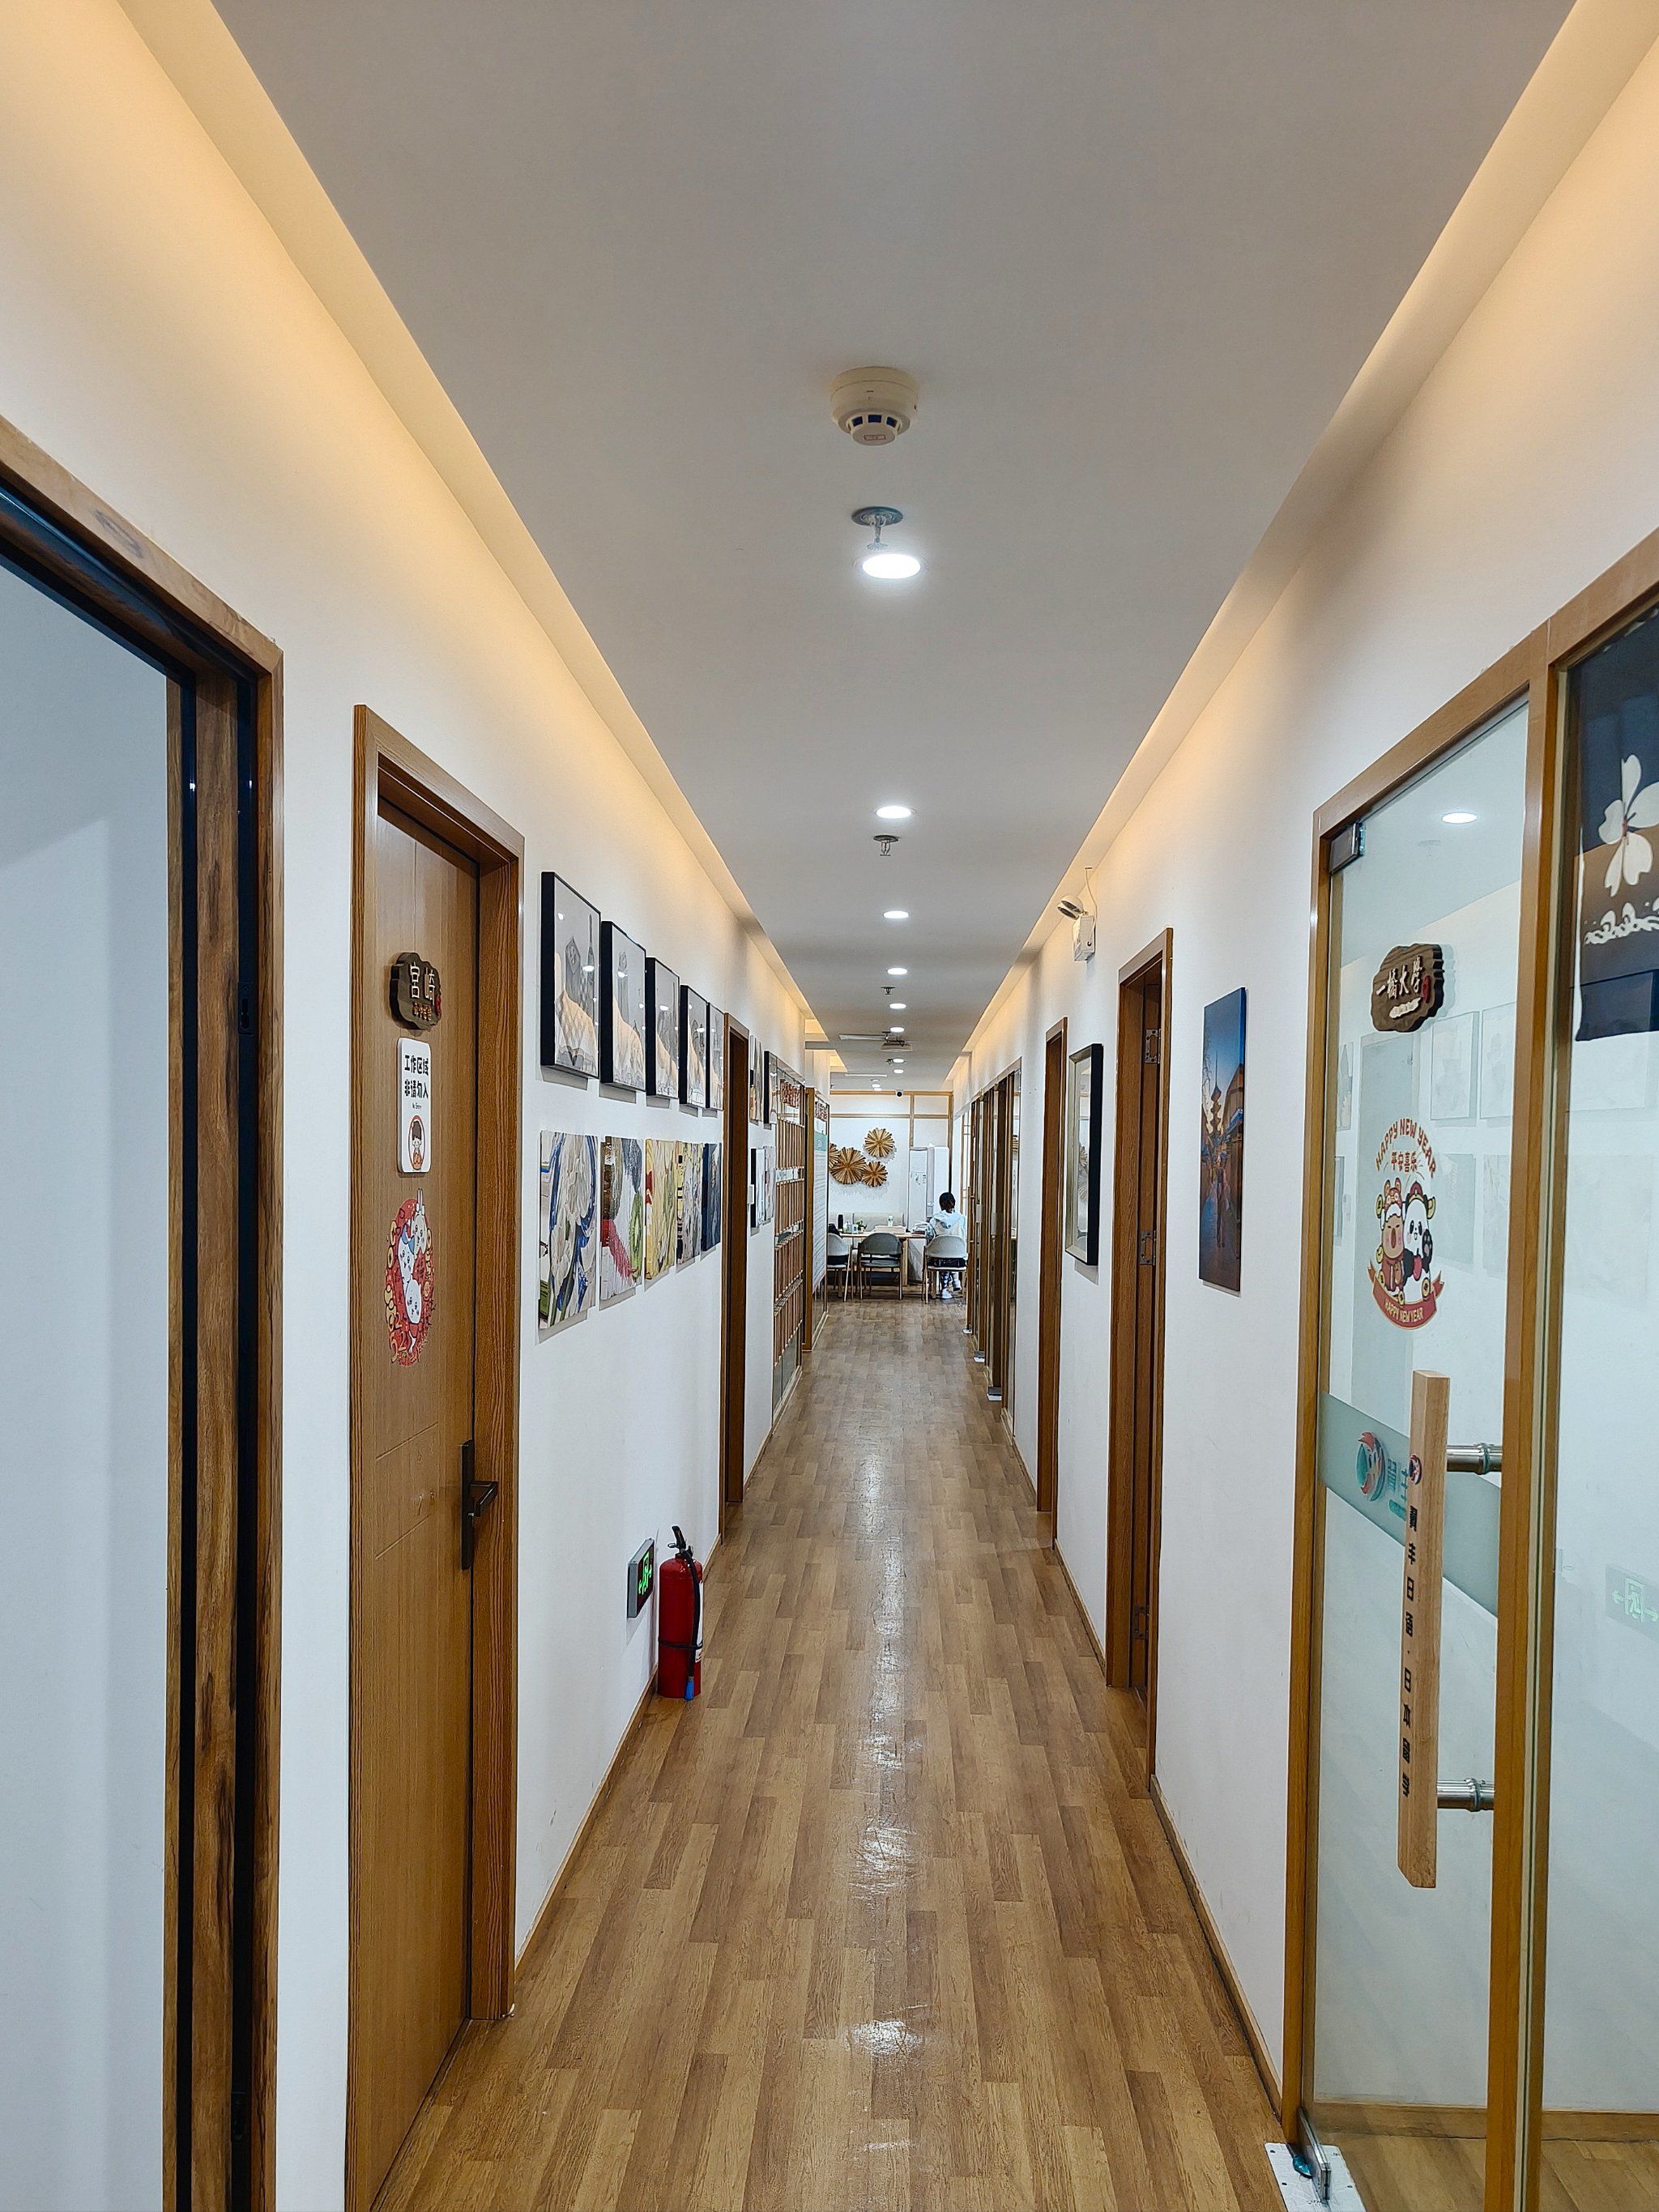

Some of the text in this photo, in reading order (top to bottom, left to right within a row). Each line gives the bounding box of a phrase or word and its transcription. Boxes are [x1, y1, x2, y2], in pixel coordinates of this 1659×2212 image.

[404, 1055, 429, 1076] 工作区域
[404, 1079, 429, 1098] 非请勿入
[1375, 1118, 1436, 1178] HAPPY NEW YEAR
[1391, 1150, 1418, 1173] 平安喜乐
[1384, 1298, 1424, 1323] HAPPY NEW YEAR
